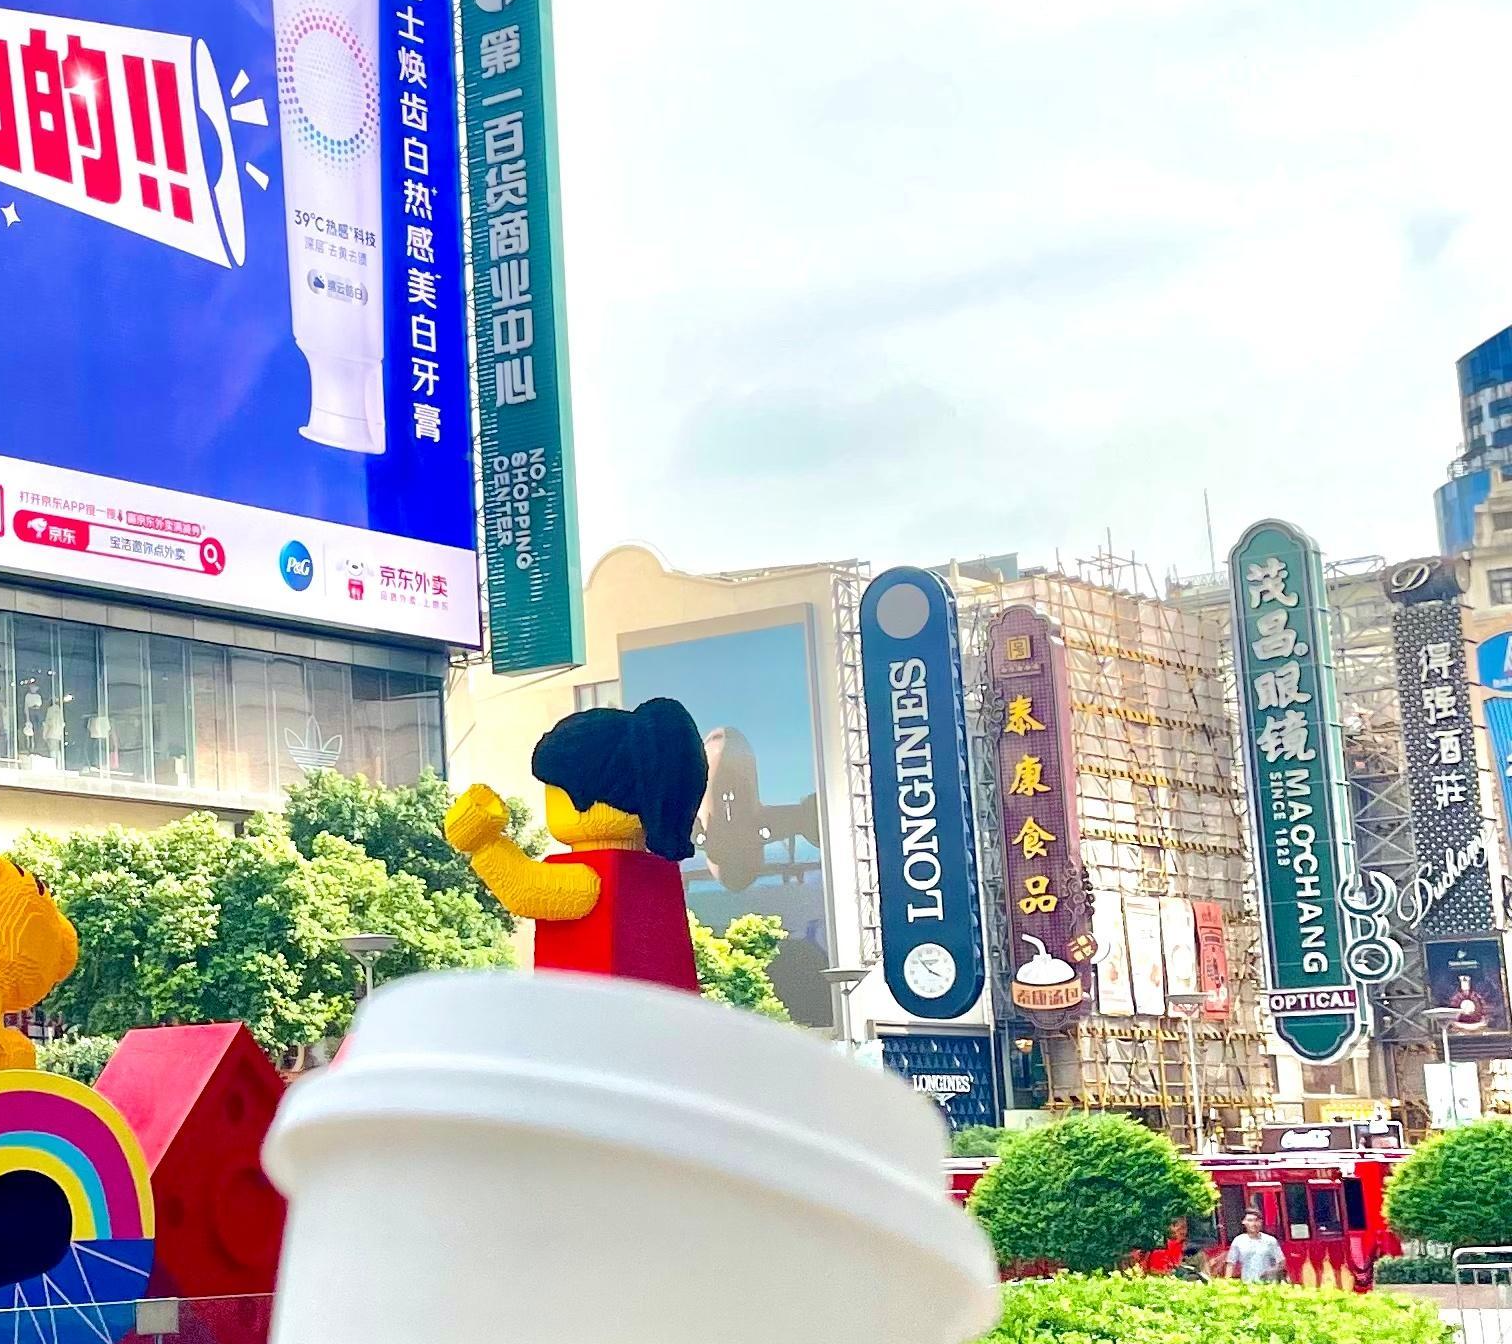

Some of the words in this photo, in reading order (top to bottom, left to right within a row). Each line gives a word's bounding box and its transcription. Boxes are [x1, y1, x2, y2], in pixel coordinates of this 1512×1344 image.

[478, 24, 537, 408] 第一百货商业中心
[48, 526, 77, 545] 京东
[492, 454, 513, 547] CENTER
[510, 451, 533, 570] SHOPPING
[286, 556, 313, 576] P&G
[380, 566, 448, 598] 京东外卖
[1246, 557, 1317, 763] 茂昌眼镜
[888, 657, 945, 923] LONGINES
[1004, 694, 1059, 915] 泰康食品
[1268, 771, 1286, 821] SINCE
[1285, 768, 1330, 974] MAOCHANG
[1270, 991, 1356, 1011] OPTICAL
[912, 1074, 971, 1093] LONGINES
